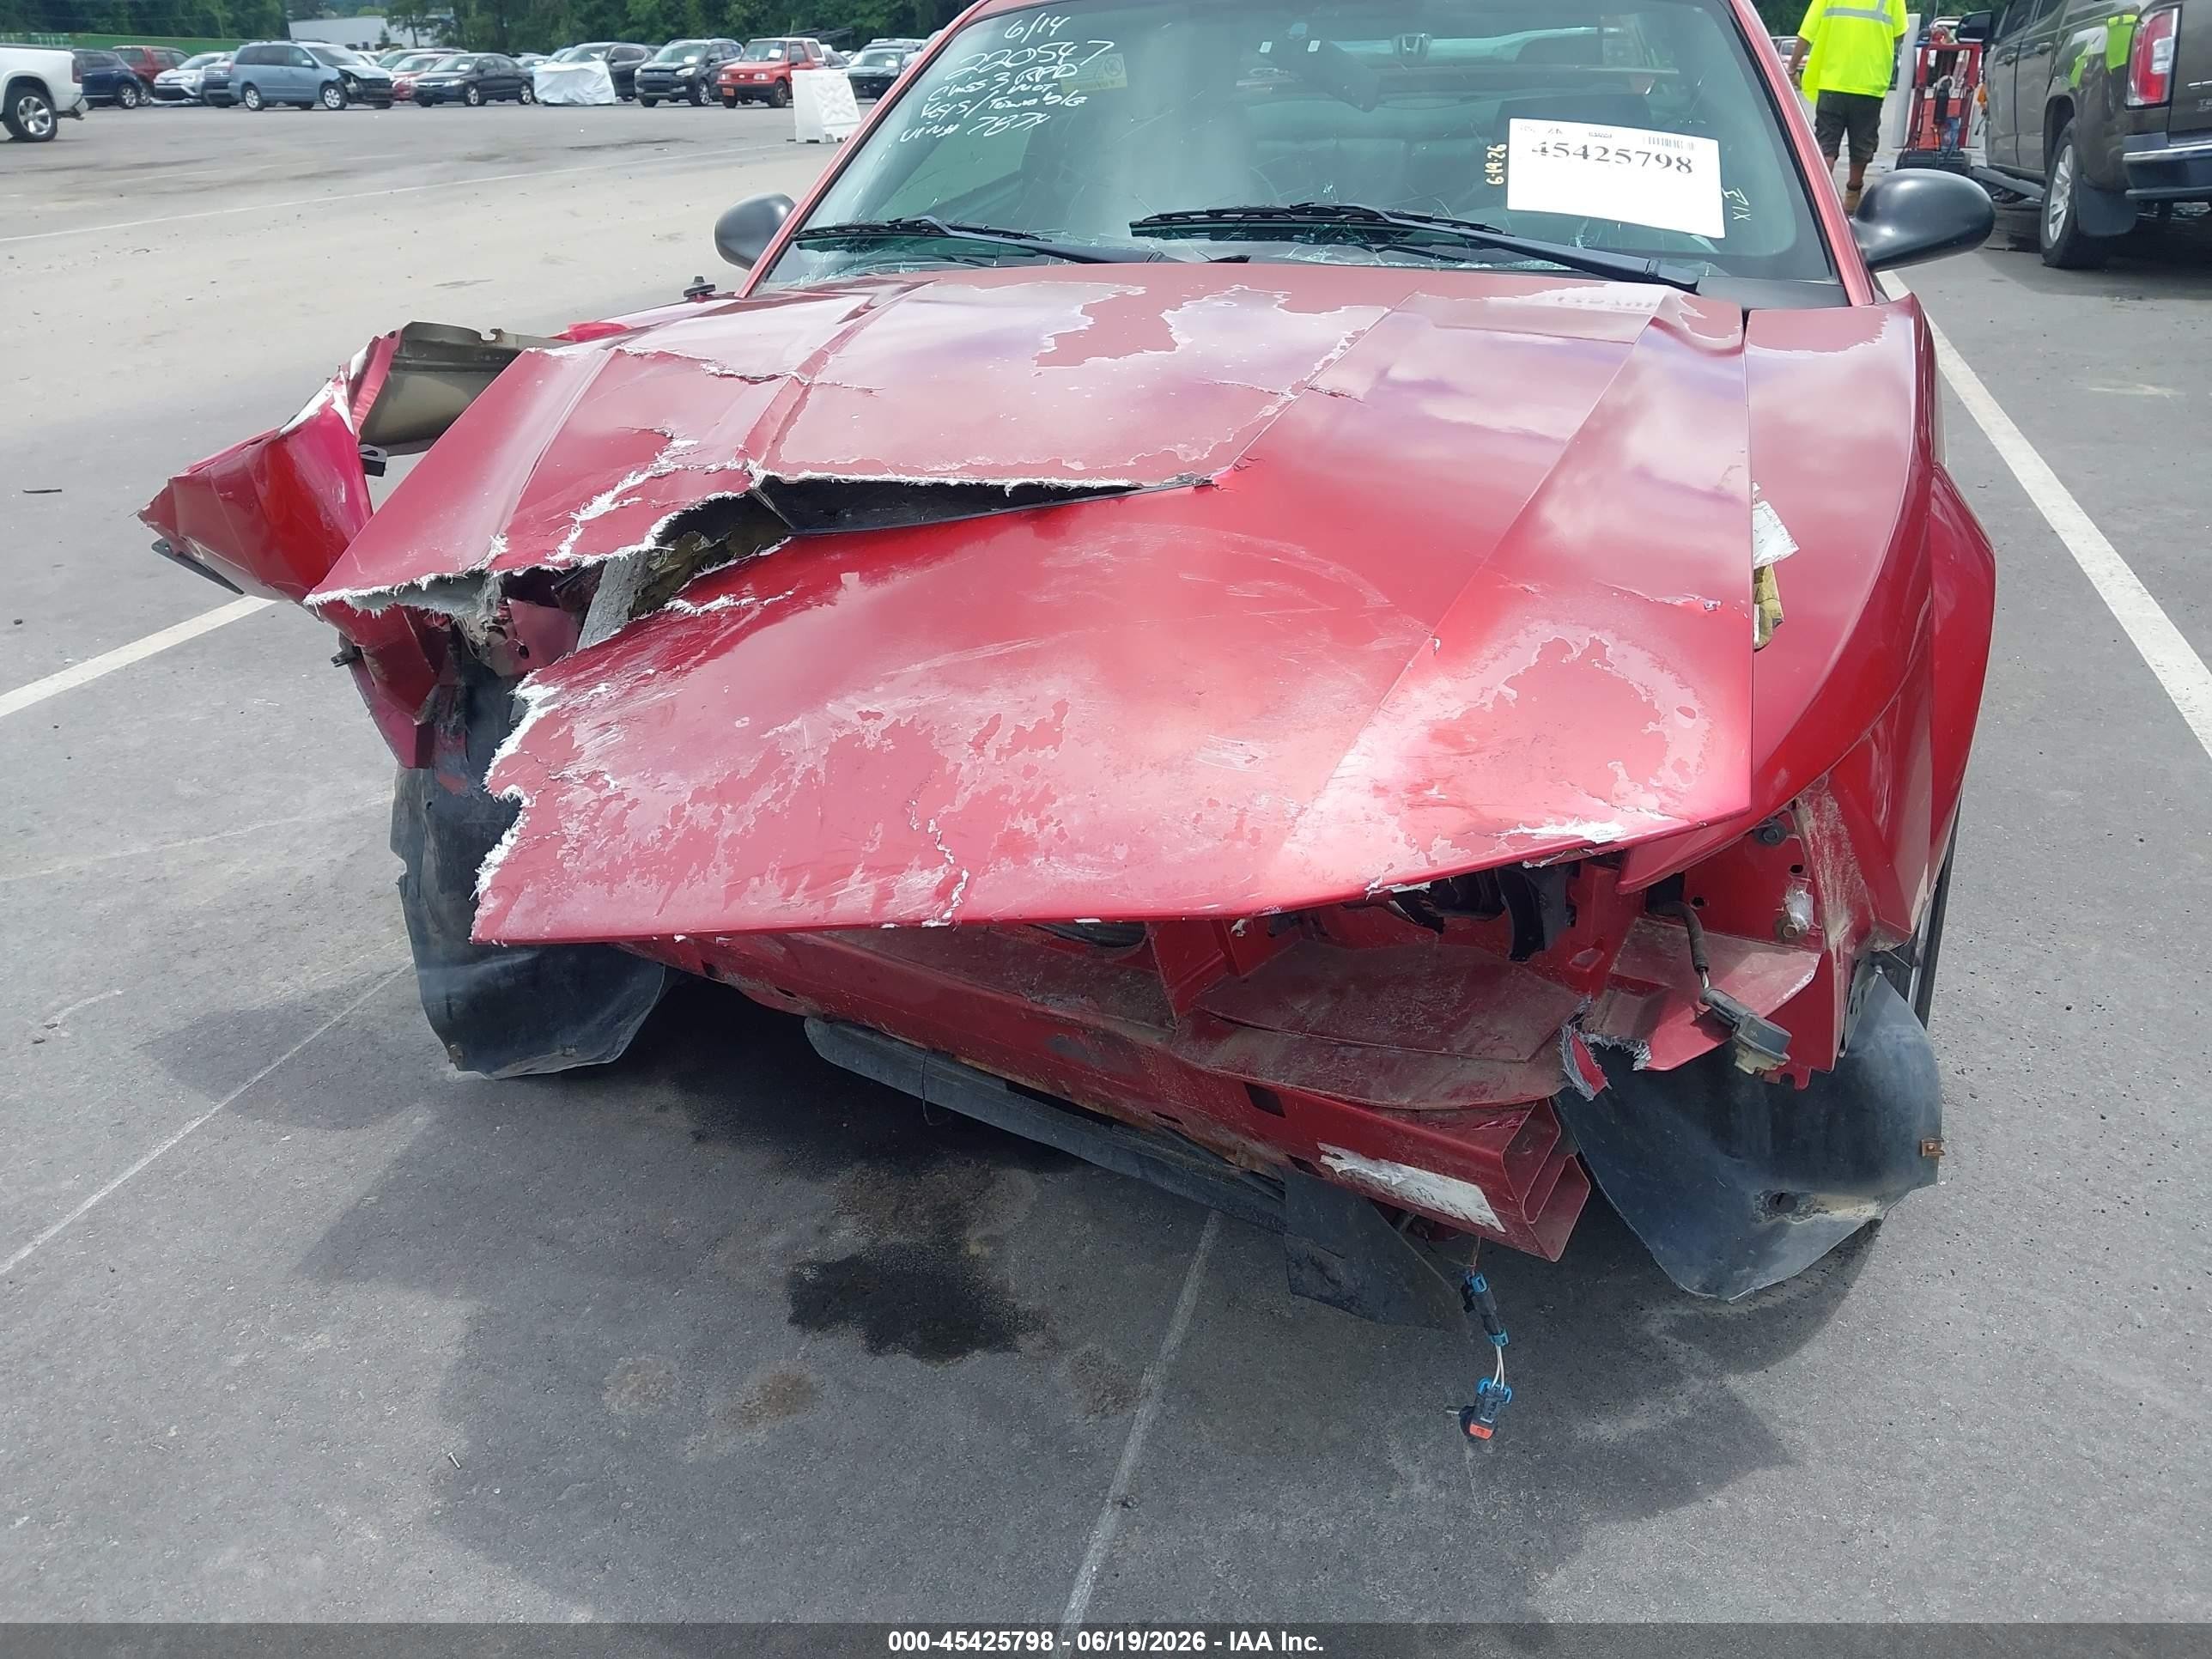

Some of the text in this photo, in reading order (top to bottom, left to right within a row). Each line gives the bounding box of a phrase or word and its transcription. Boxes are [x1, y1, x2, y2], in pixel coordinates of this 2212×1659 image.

[1004, 13, 1071, 43] 6/14
[989, 72, 1011, 91] 3
[1532, 142, 1693, 173] 45425798
